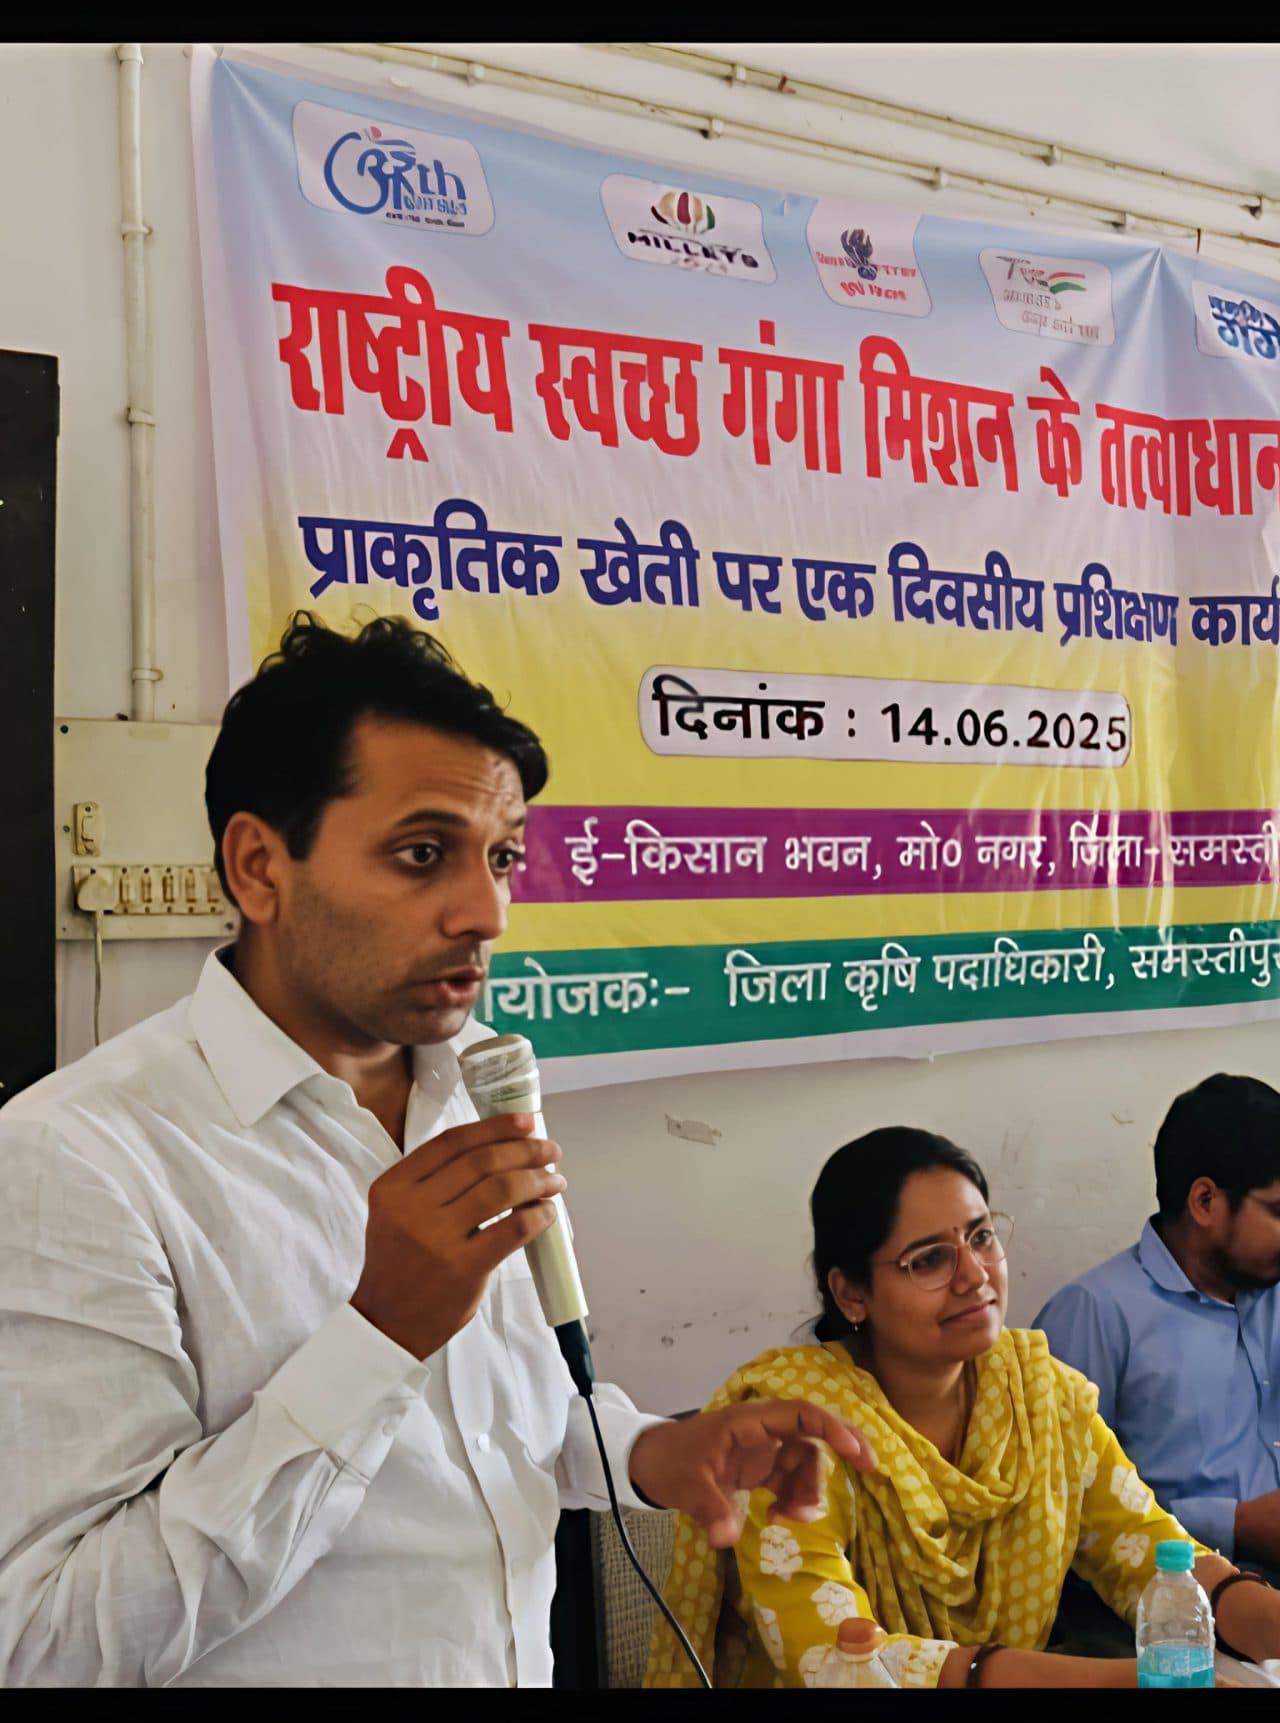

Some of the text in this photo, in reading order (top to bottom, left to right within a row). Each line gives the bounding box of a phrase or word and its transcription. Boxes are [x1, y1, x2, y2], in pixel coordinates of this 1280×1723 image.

[271, 265, 513, 462] राष्ट्रीय
[528, 323, 703, 456] स्वच्छ
[719, 319, 843, 475] गंगा
[859, 335, 1019, 493] मिशन
[1027, 366, 1082, 497] के
[298, 498, 562, 620] प्राकृतिक
[577, 517, 700, 607] खेती
[712, 551, 782, 614] पर
[792, 557, 876, 621] एक
[887, 542, 1045, 634] दिवसीय
[1053, 562, 1180, 647] प्रशिक्षण
[651, 674, 826, 742] दिनांक
[880, 702, 1127, 754] 14.06.2025
[564, 817, 768, 885] ई-किसान
[785, 836, 882, 880] भवन,
[975, 835, 1056, 876] नगर,
[725, 949, 831, 1006] जिला
[843, 942, 921, 1012] कृषि
[932, 932, 1115, 990] पदाधिकारी,
